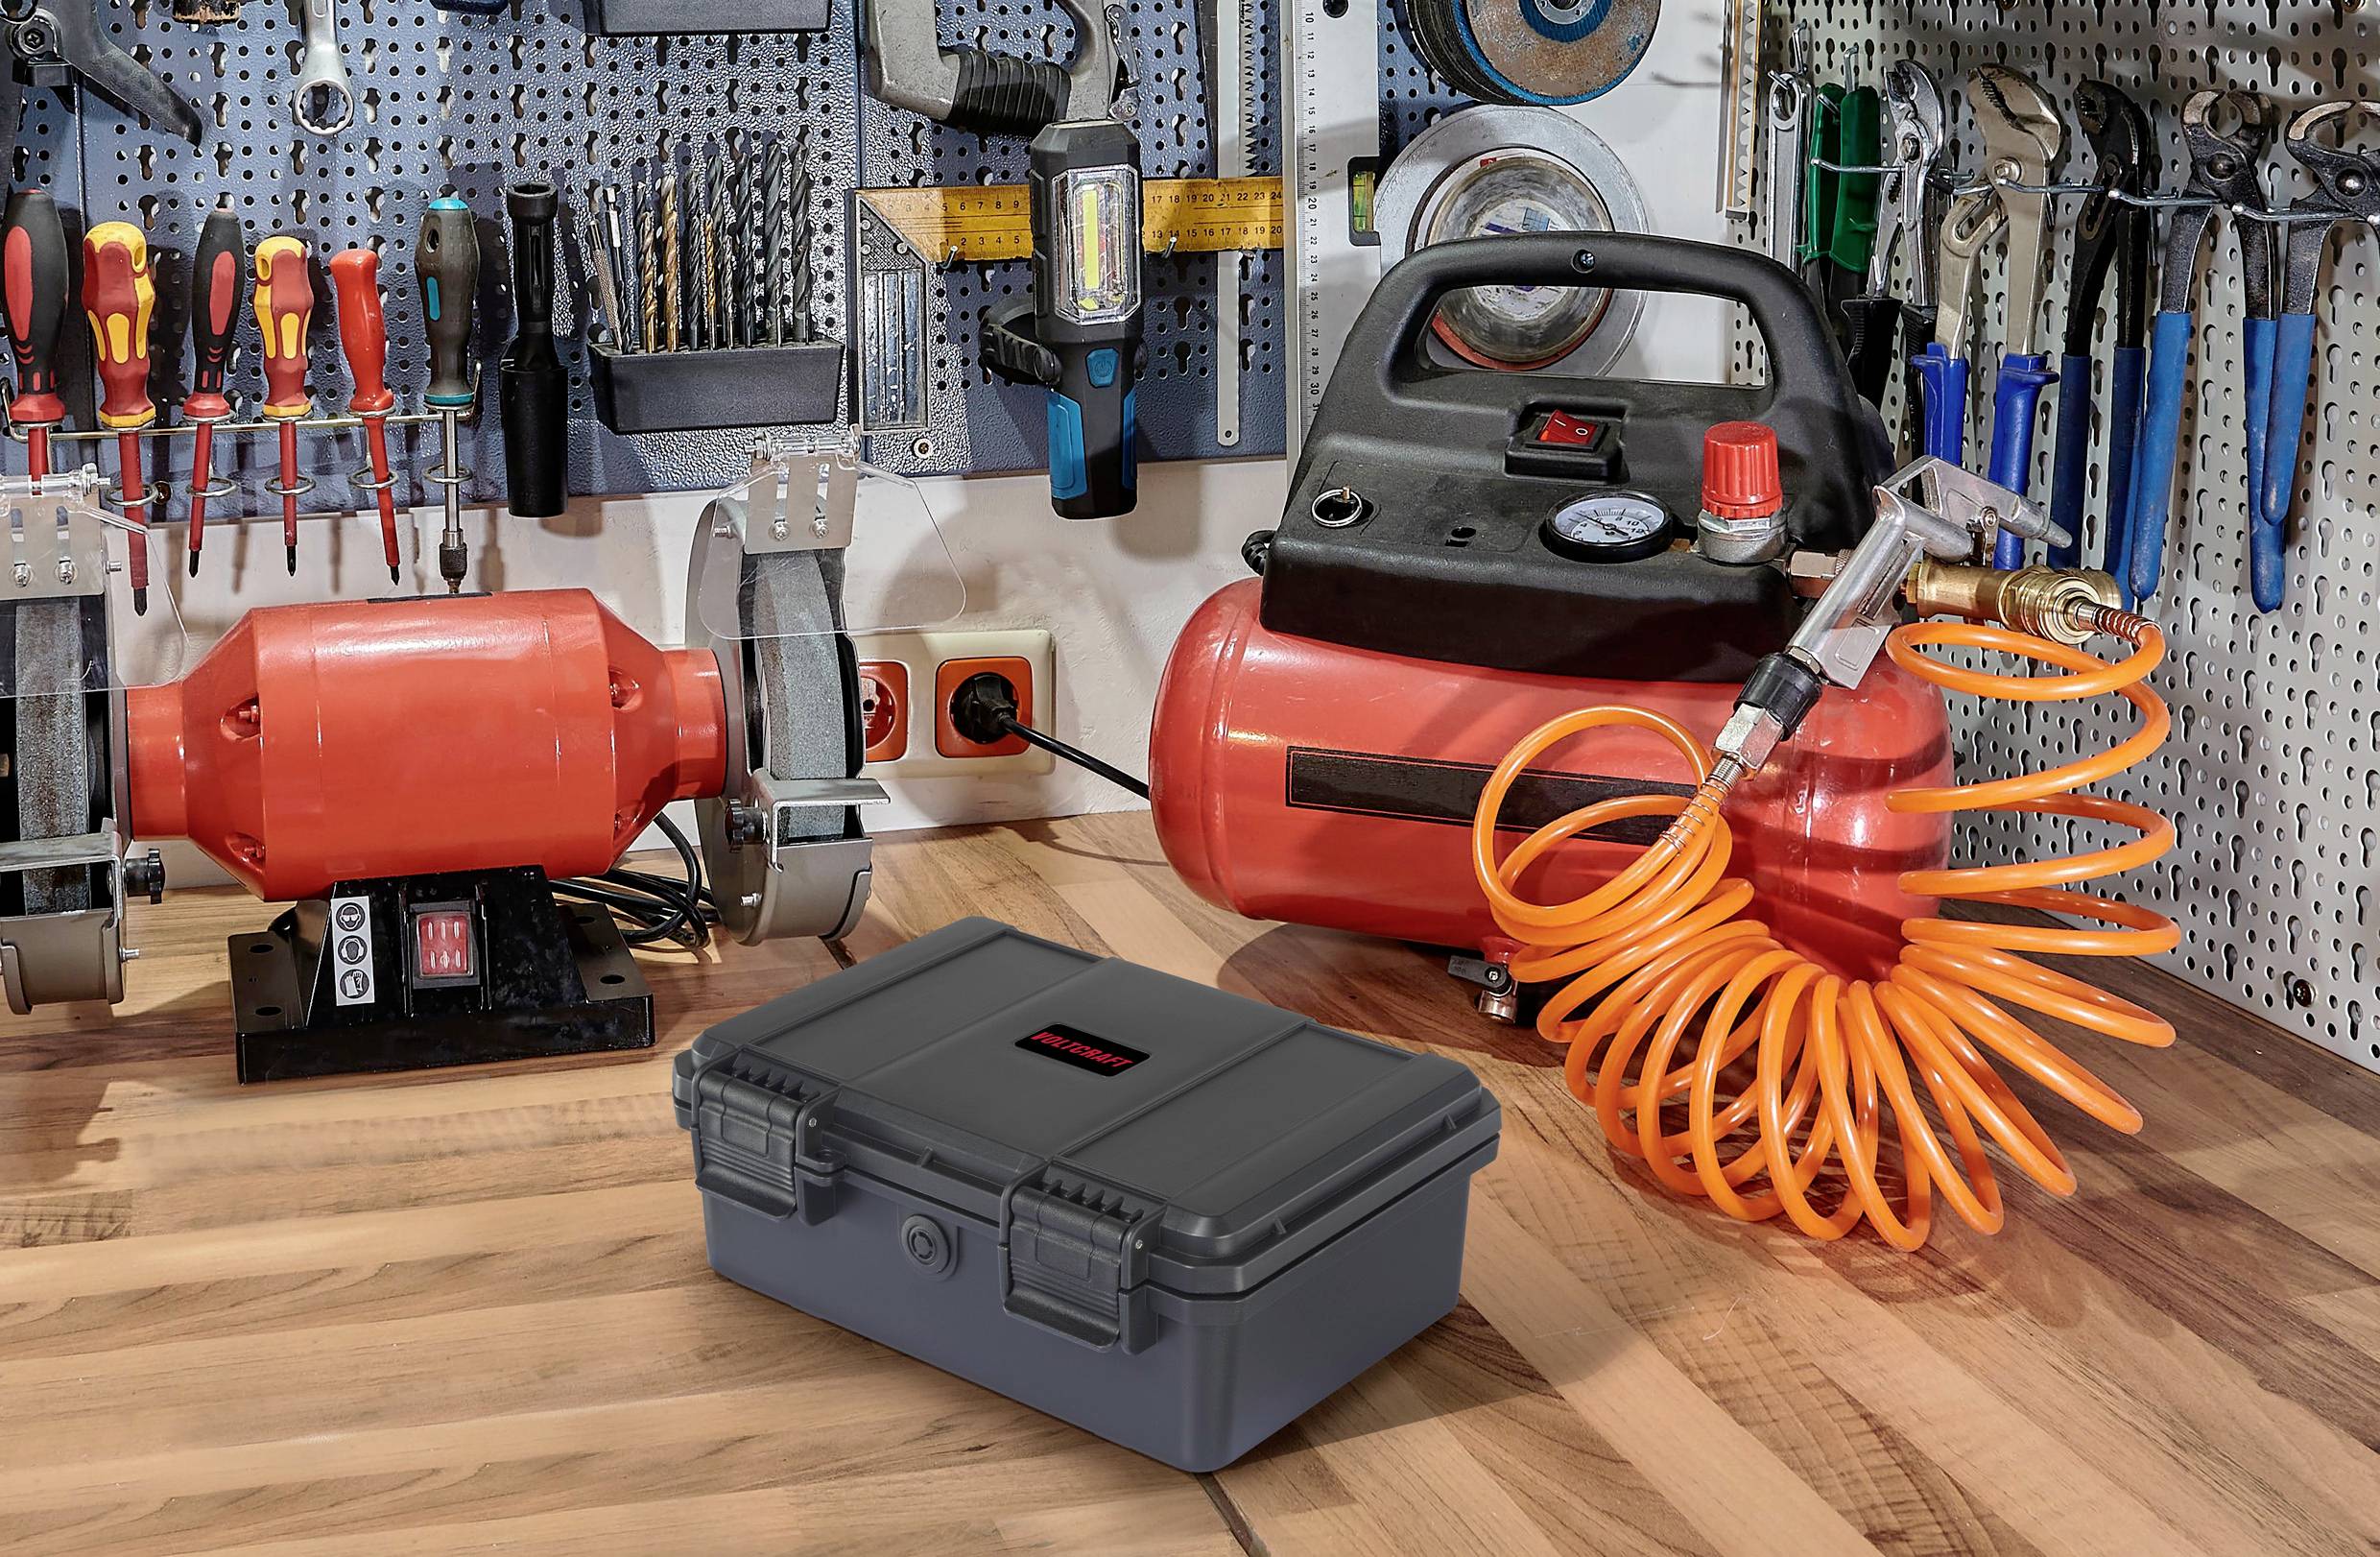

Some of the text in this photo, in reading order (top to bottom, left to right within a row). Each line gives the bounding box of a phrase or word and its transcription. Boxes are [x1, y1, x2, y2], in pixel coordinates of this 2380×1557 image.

[1305, 12, 1314, 23] 10
[1307, 51, 1315, 60] 12
[1308, 107, 1315, 115] 15
[1309, 162, 1316, 171] 18
[942, 203, 948, 211] 5
[960, 202, 966, 211] 6
[995, 201, 1002, 209] 8
[1012, 200, 1019, 208] 9
[1169, 195, 1179, 204] 18
[1220, 193, 1230, 202] 21
[1237, 192, 1249, 201] 22
[1254, 192, 1265, 201] 23
[1308, 198, 1317, 209] 20
[961, 237, 967, 246] 2
[979, 236, 985, 245] 3
[1203, 228, 1214, 237] 16
[1221, 228, 1231, 236] 17
[1271, 226, 1282, 234] 20
[1311, 274, 1318, 282] 24
[1311, 292, 1318, 300] 25
[1311, 310, 1319, 319] 26
[1312, 347, 1319, 356] 28
[1312, 366, 1319, 374] 29
[1311, 383, 1319, 395] 30
[1031, 1032, 1134, 1067] VOLTCRAFT
